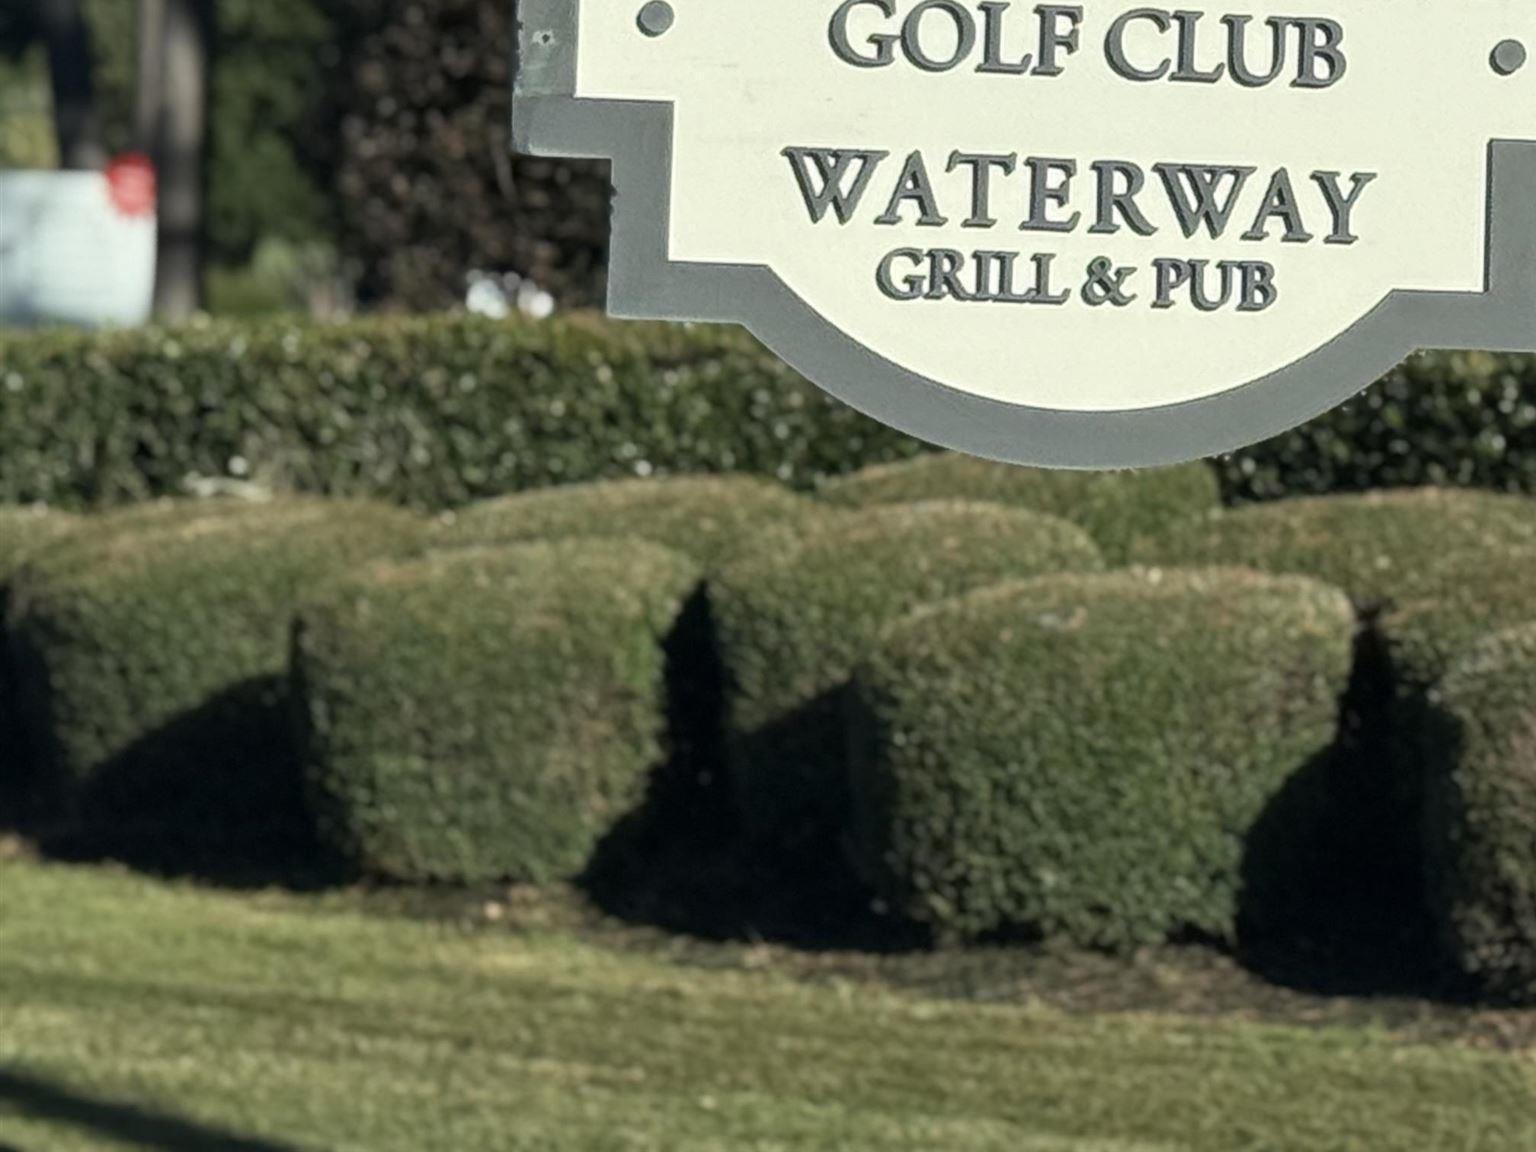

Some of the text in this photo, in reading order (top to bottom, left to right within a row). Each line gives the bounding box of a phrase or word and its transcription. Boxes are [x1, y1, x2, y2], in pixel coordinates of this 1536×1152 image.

[1103, 7, 1348, 89] CLUB
[781, 146, 1377, 245] WATERWAY
[875, 248, 1279, 312] GRILL & PUB
